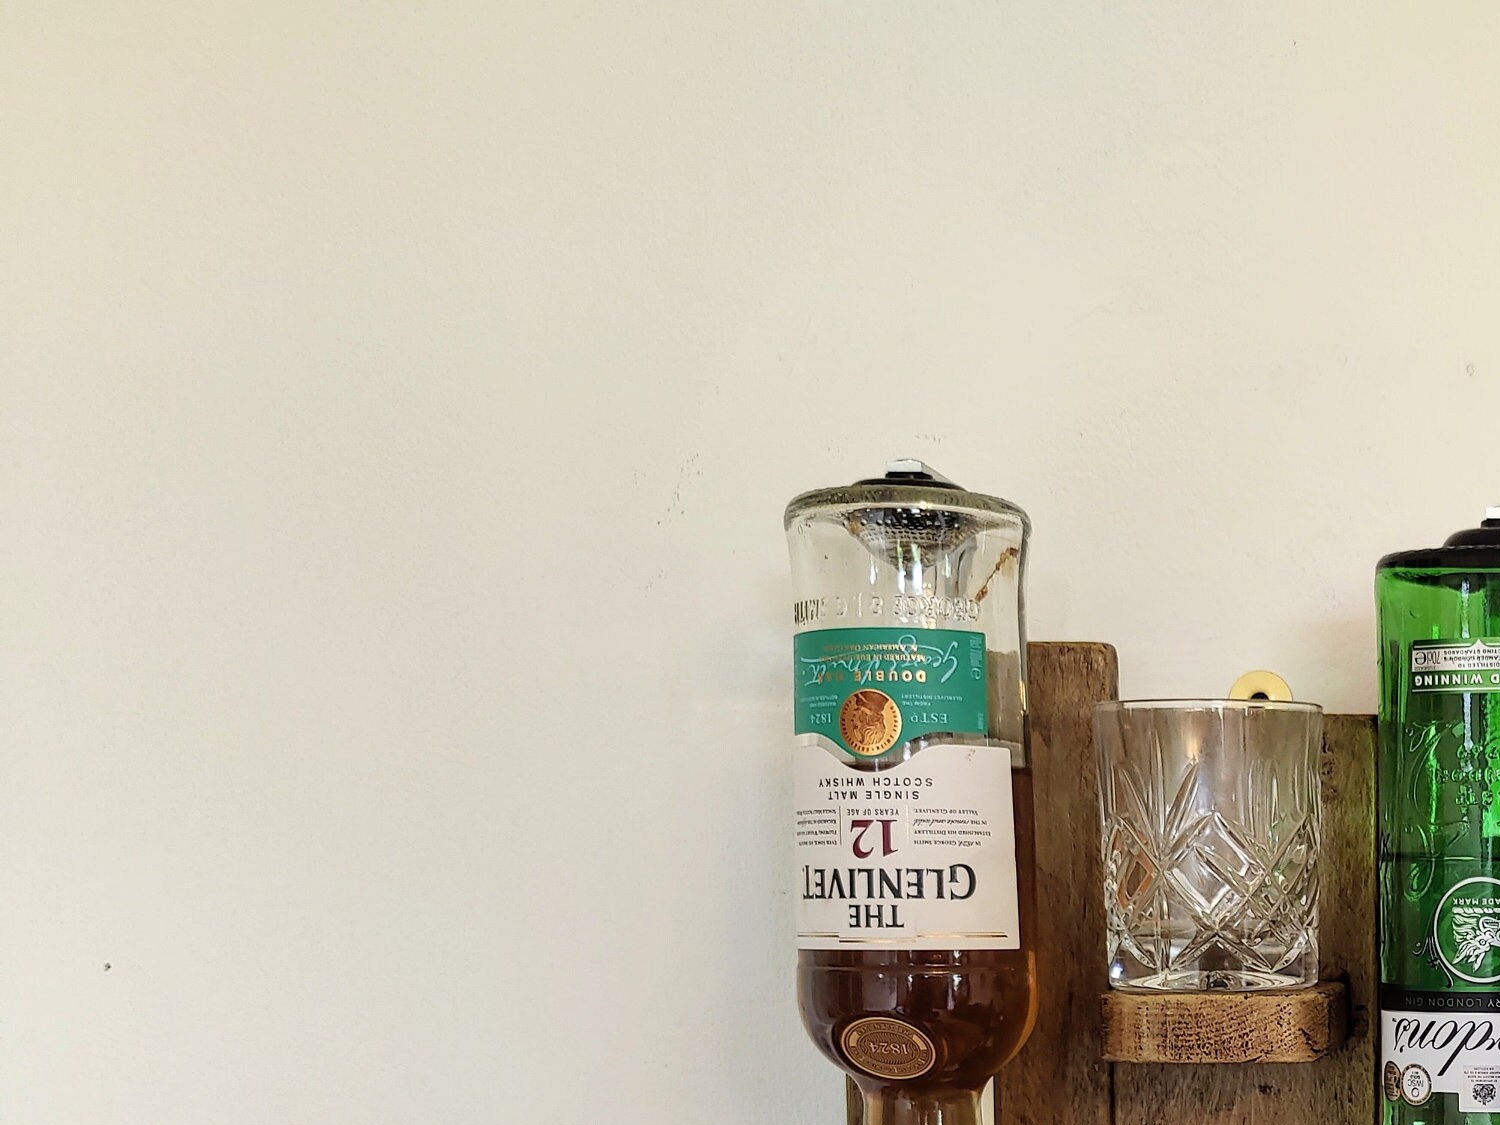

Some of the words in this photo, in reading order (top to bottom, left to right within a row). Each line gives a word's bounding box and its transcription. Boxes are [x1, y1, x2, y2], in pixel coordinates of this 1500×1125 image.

[854, 670, 926, 683] DOUBLE
[1414, 674, 1483, 686] WINNING
[810, 712, 831, 724] 1824
[818, 777, 864, 787] WHISKY
[872, 777, 933, 787] SCOTCH
[827, 791, 857, 800] MALT
[865, 790, 919, 800] SINGLE
[846, 808, 859, 816] AGE
[861, 808, 871, 816] OF
[874, 808, 899, 816] YEARS
[850, 819, 898, 859] 12
[1452, 897, 1479, 905] MARK
[848, 904, 904, 928] THE
[1405, 997, 1423, 1006] GIN
[1428, 998, 1482, 1007] LONDON
[869, 1041, 910, 1055] 1824
